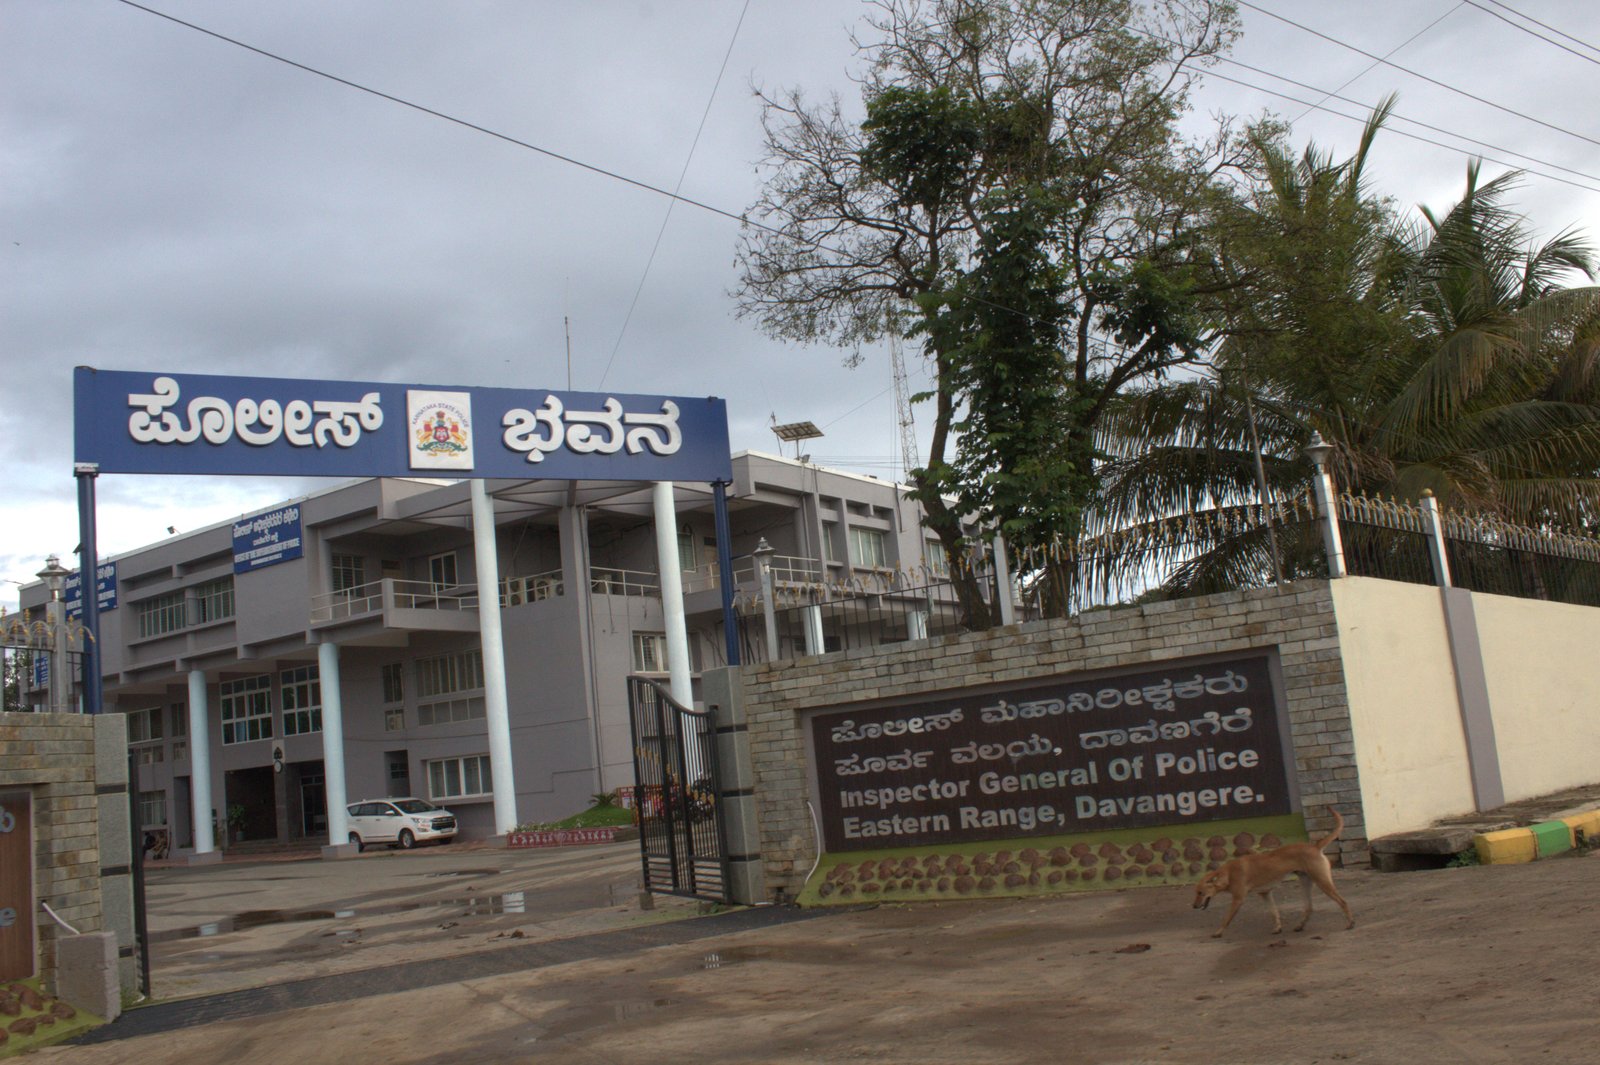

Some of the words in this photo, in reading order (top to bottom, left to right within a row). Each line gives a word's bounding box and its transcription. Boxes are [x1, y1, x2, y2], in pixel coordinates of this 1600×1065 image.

[127, 376, 384, 448] ಪೊಲೀಸ್
[501, 394, 683, 463] ಭವನ
[438, 402, 455, 412] STATE
[831, 708, 964, 743] ಪೊಲೀಸ್
[980, 670, 1248, 723] ಮಹಾನಿರೀಕ್ಷಕರು
[834, 748, 934, 776] ಪೂರ್ವ
[951, 733, 1063, 764] ವಲಯ,
[1079, 707, 1253, 750] ದಾವಣಗೆರೆ
[840, 778, 970, 809] Inspector
[979, 761, 1099, 795] General
[1108, 755, 1143, 782] Of
[1155, 747, 1259, 777] Police
[843, 813, 950, 839] Eastern
[959, 804, 1066, 830] Range,
[1075, 784, 1265, 819] Davangere.
